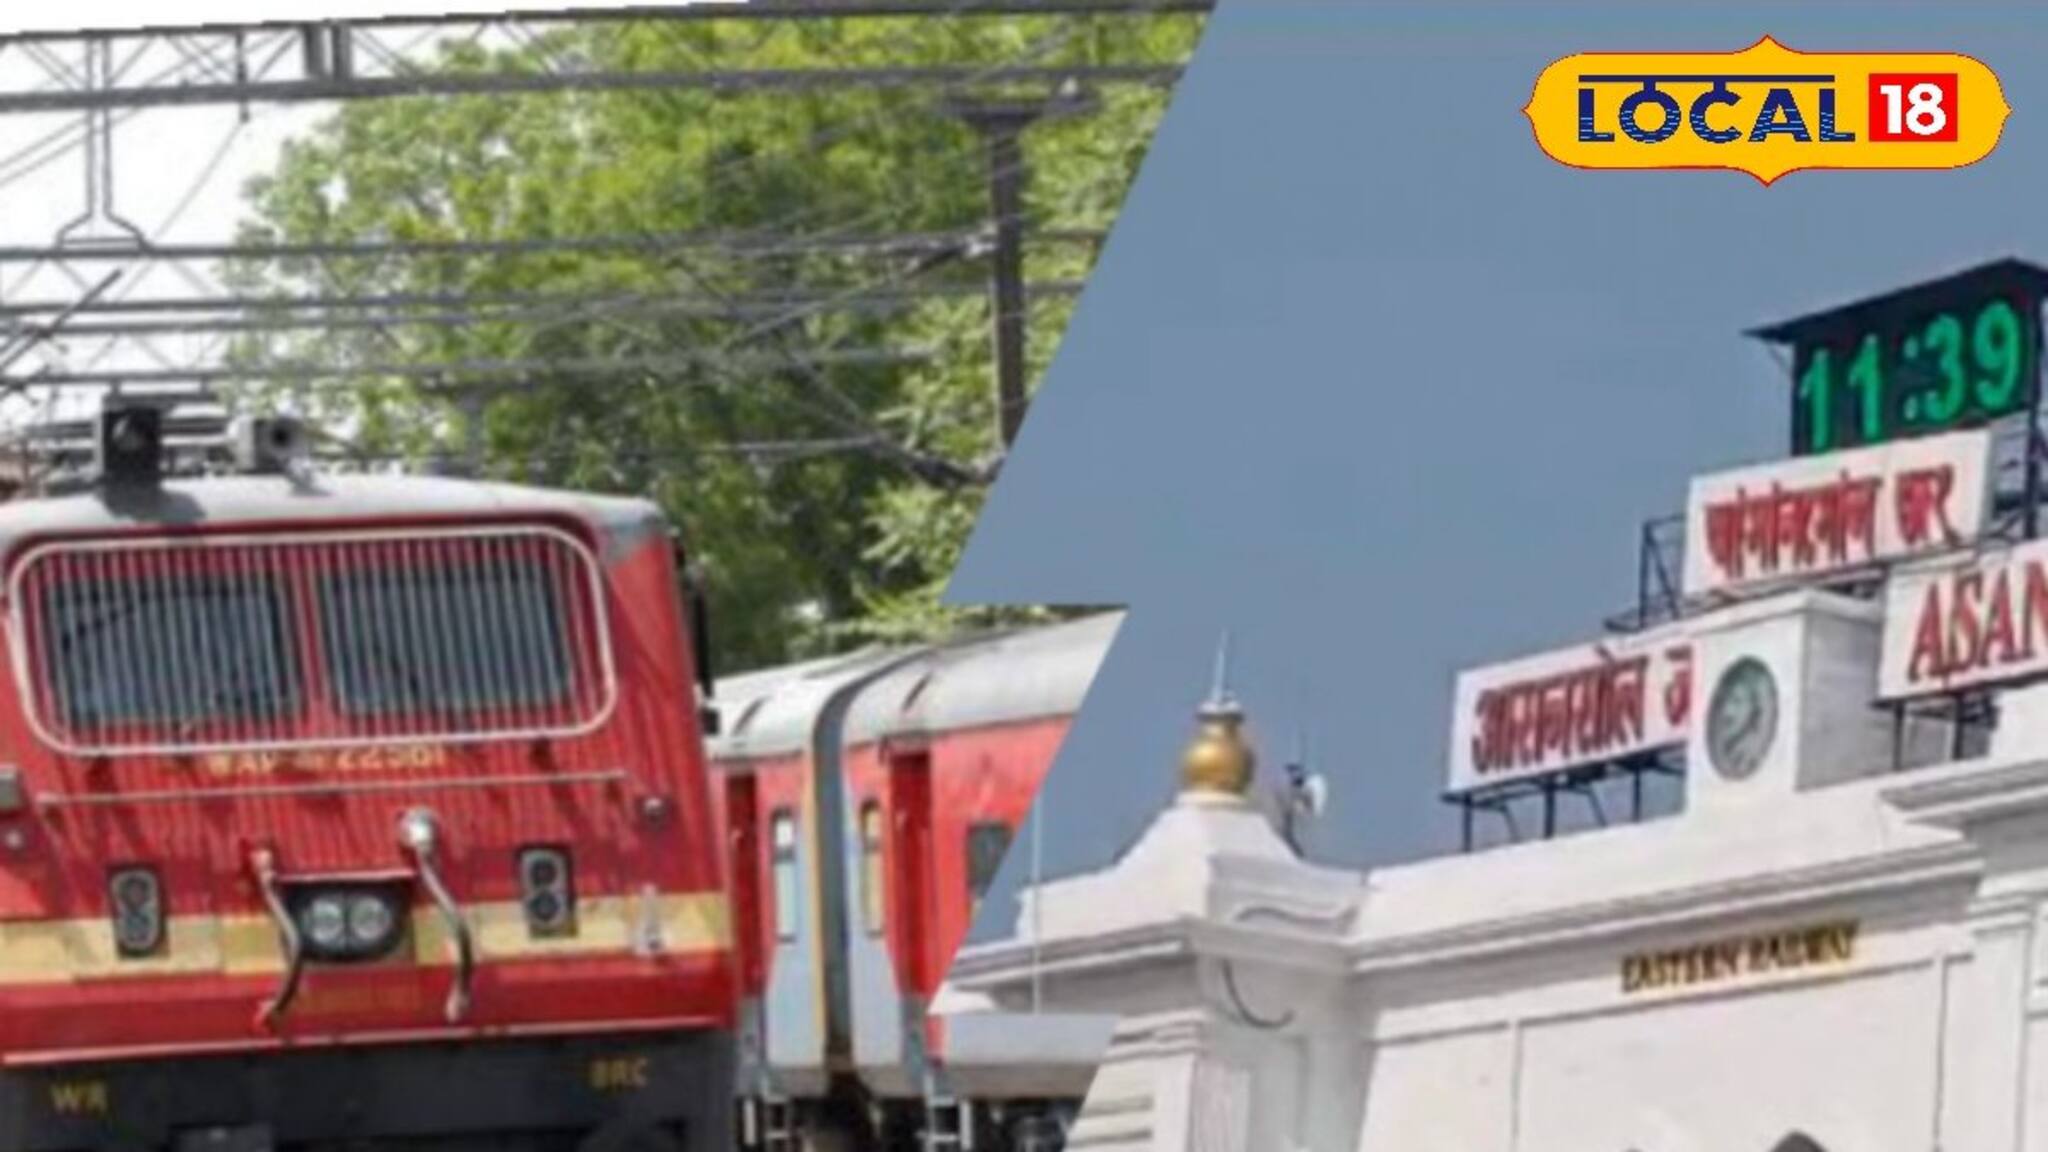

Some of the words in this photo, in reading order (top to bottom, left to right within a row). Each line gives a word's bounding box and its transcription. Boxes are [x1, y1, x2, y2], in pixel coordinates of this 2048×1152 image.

[1801, 298, 2022, 451] 11:39
[1620, 938, 1743, 993] EASTERN
[1747, 919, 1860, 973] RAILWAY
